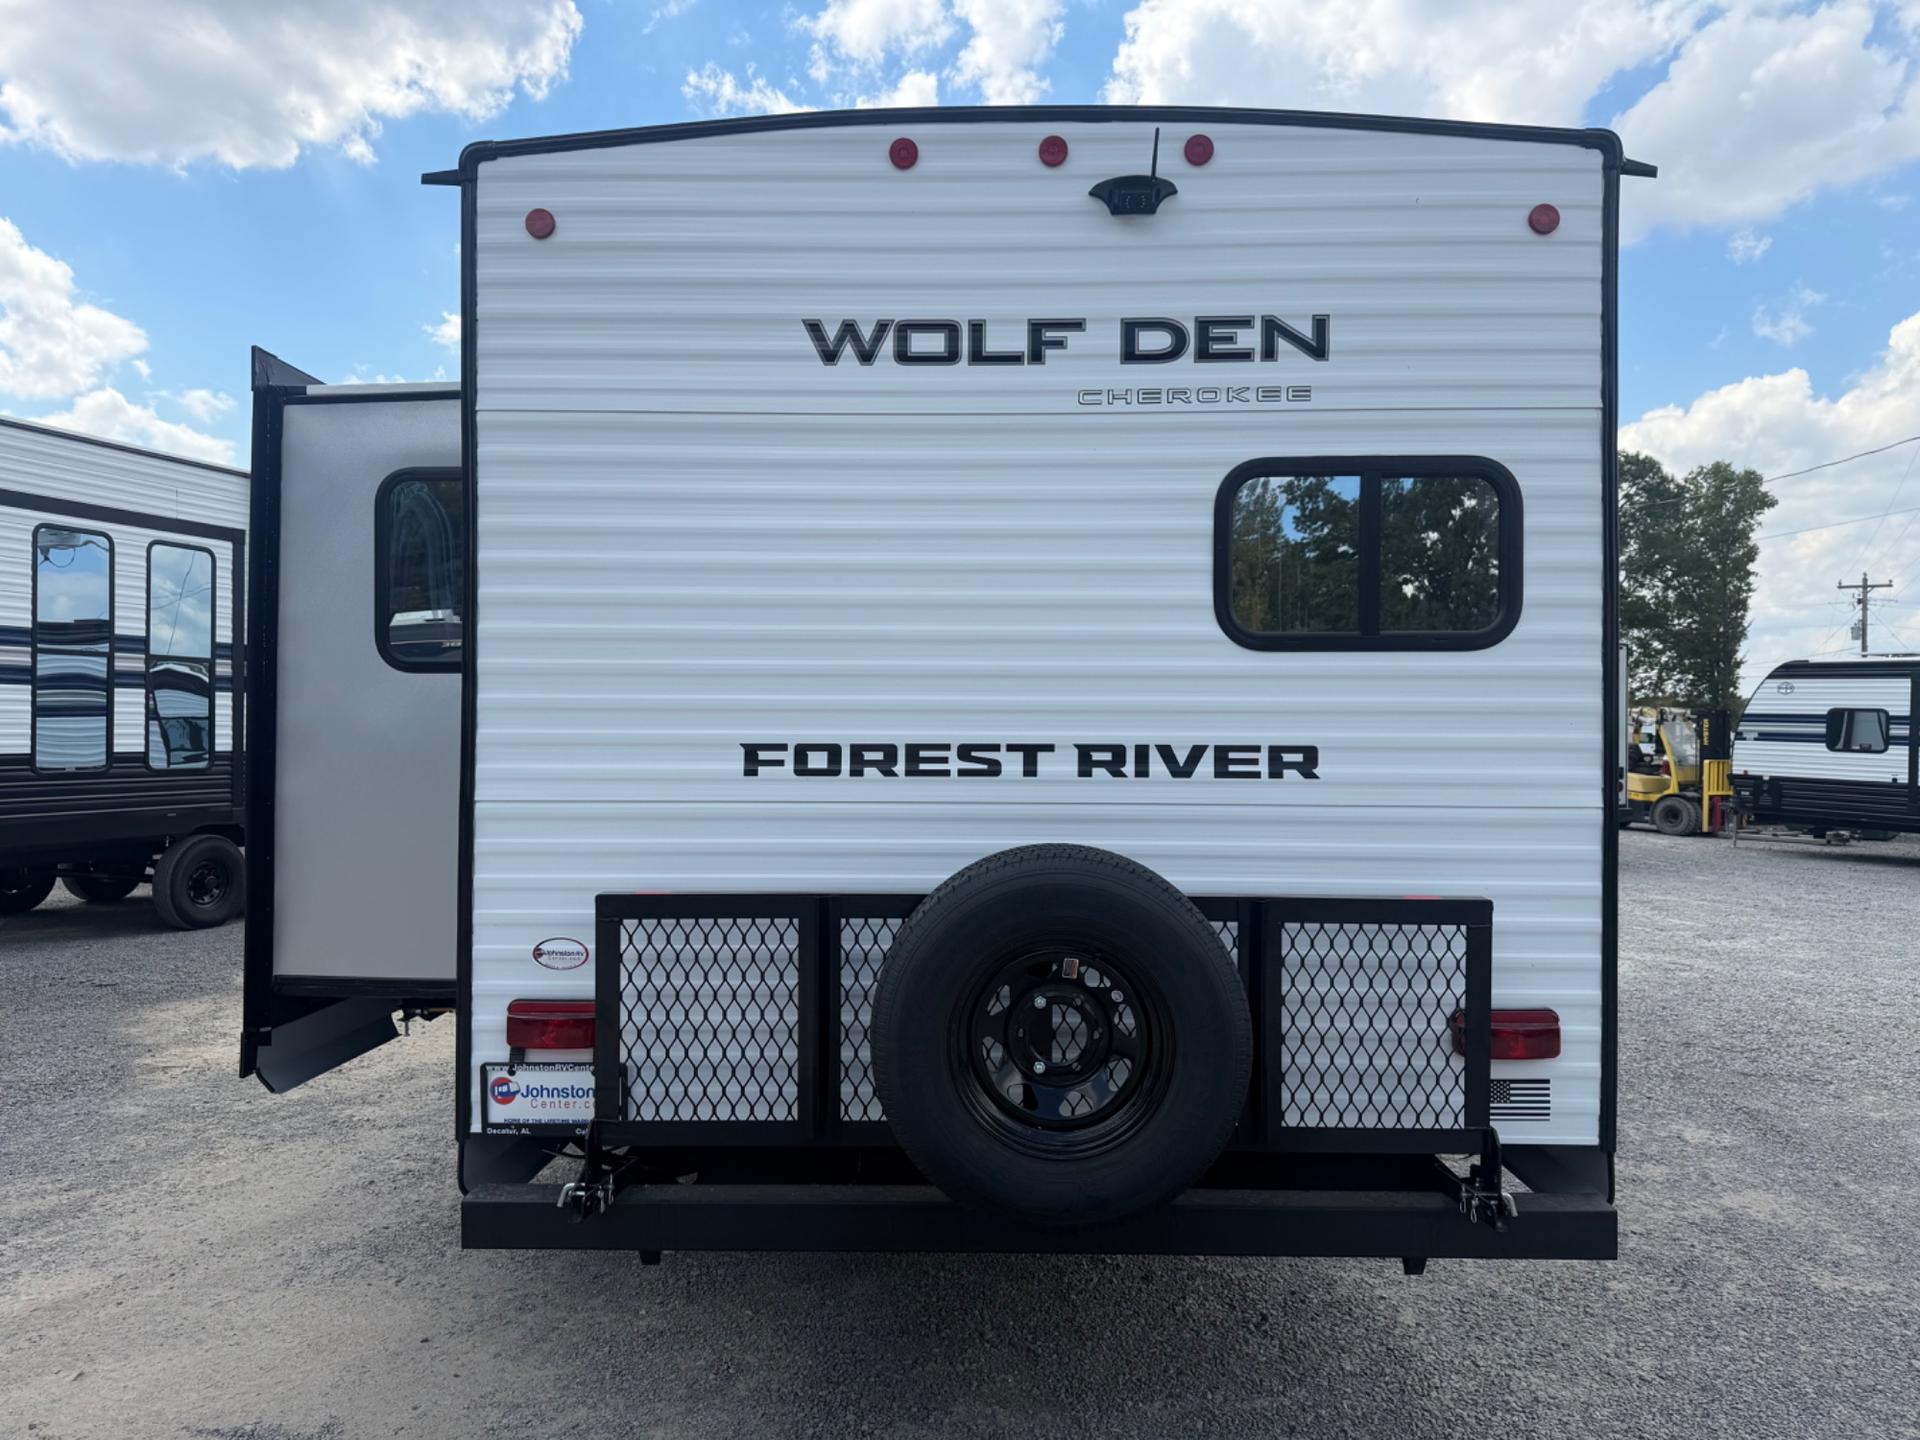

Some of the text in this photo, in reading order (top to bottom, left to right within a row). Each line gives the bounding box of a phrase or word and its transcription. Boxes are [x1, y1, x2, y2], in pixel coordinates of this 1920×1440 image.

[801, 314, 1331, 366] WOLF DEN
[1078, 385, 1312, 406] CHEROKEE
[739, 743, 1321, 780] FOREST RIVER
[521, 1085, 596, 1099] Johnston
[530, 1100, 596, 1109] Center.c
